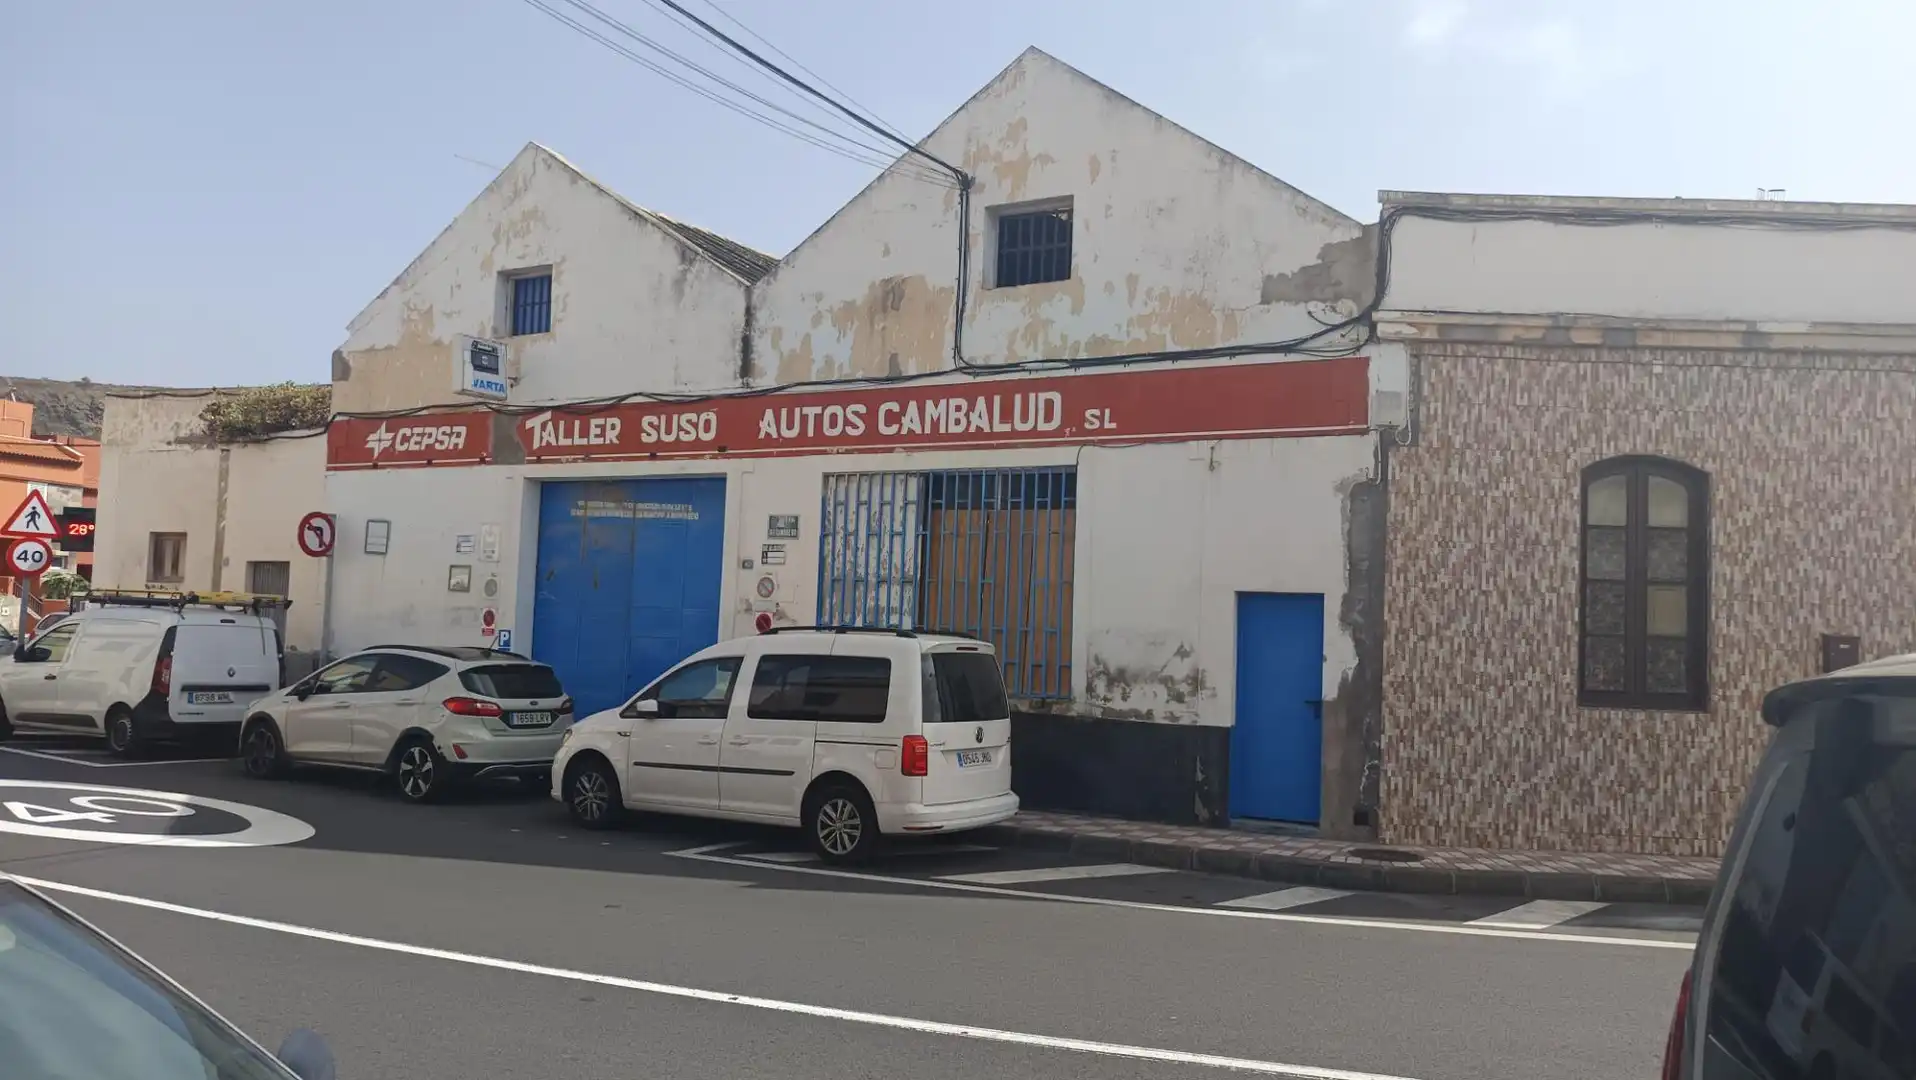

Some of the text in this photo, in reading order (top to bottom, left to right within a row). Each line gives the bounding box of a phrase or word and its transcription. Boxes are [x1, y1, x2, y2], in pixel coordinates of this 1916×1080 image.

[472, 378, 505, 393] VARTA
[757, 391, 1117, 440] AUTOS CAMBALUD SL
[395, 425, 468, 452] CEPSA
[525, 410, 621, 450] TALLER
[16, 549, 44, 564] 40
[499, 631, 510, 646] P
[3, 795, 197, 824] 40
